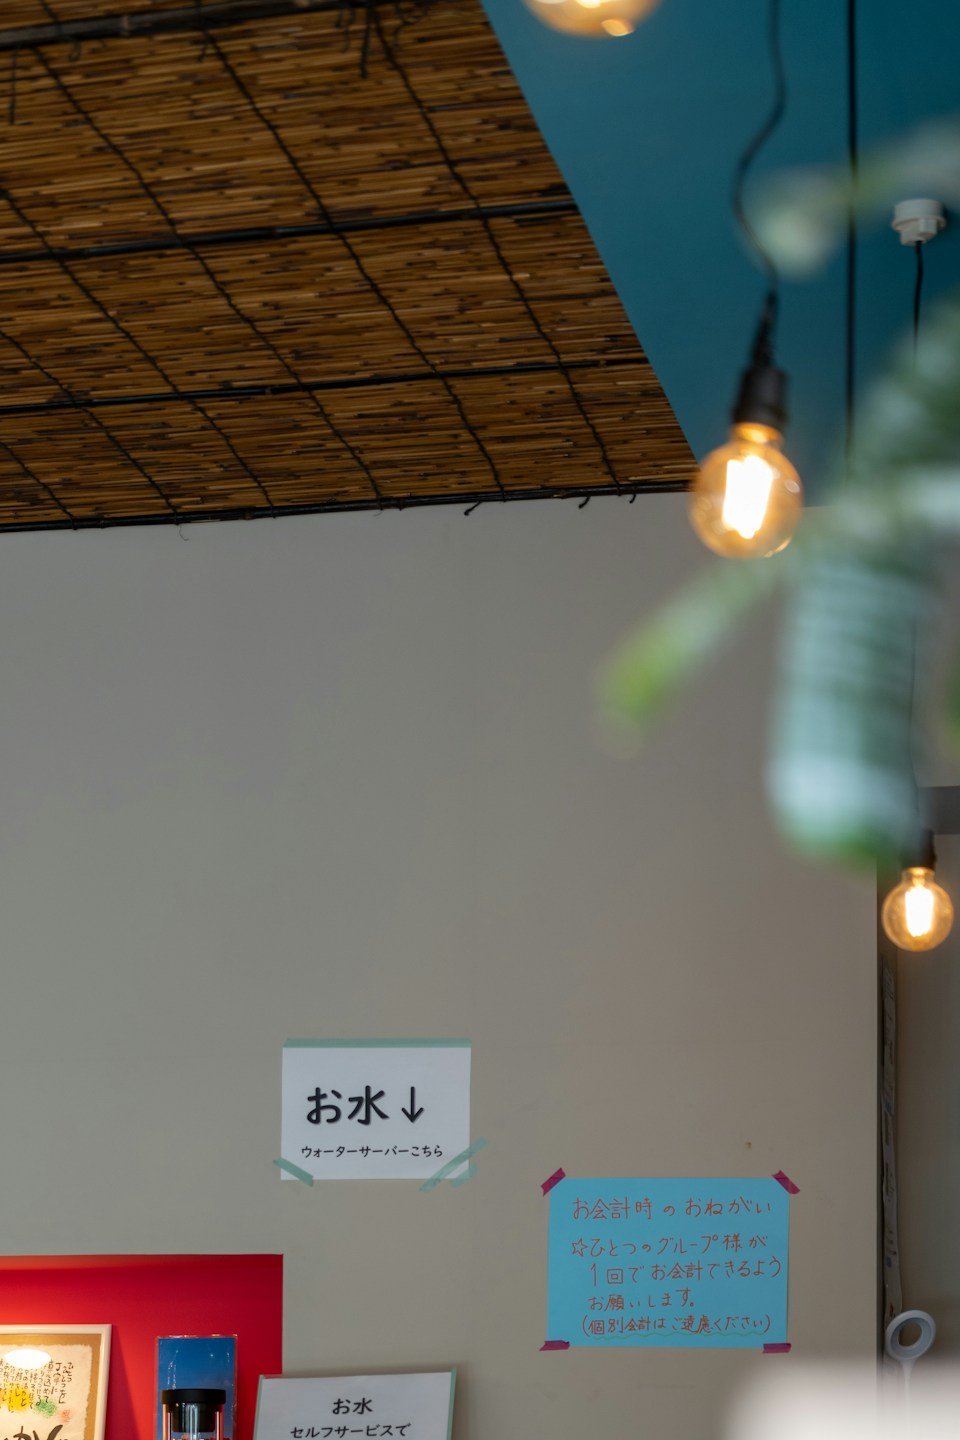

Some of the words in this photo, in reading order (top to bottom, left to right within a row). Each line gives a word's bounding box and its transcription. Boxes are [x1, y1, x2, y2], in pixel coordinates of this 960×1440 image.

[306, 1085, 390, 1125] お水
[301, 1145, 443, 1158] ウォーターサーバーこちら
[572, 1197, 771, 1220] お会計時のおねがい
[590, 1256, 782, 1287] 1回でお会計できるよう
[332, 1397, 373, 1415] お水
[290, 1422, 411, 1439] セルフサービスで
